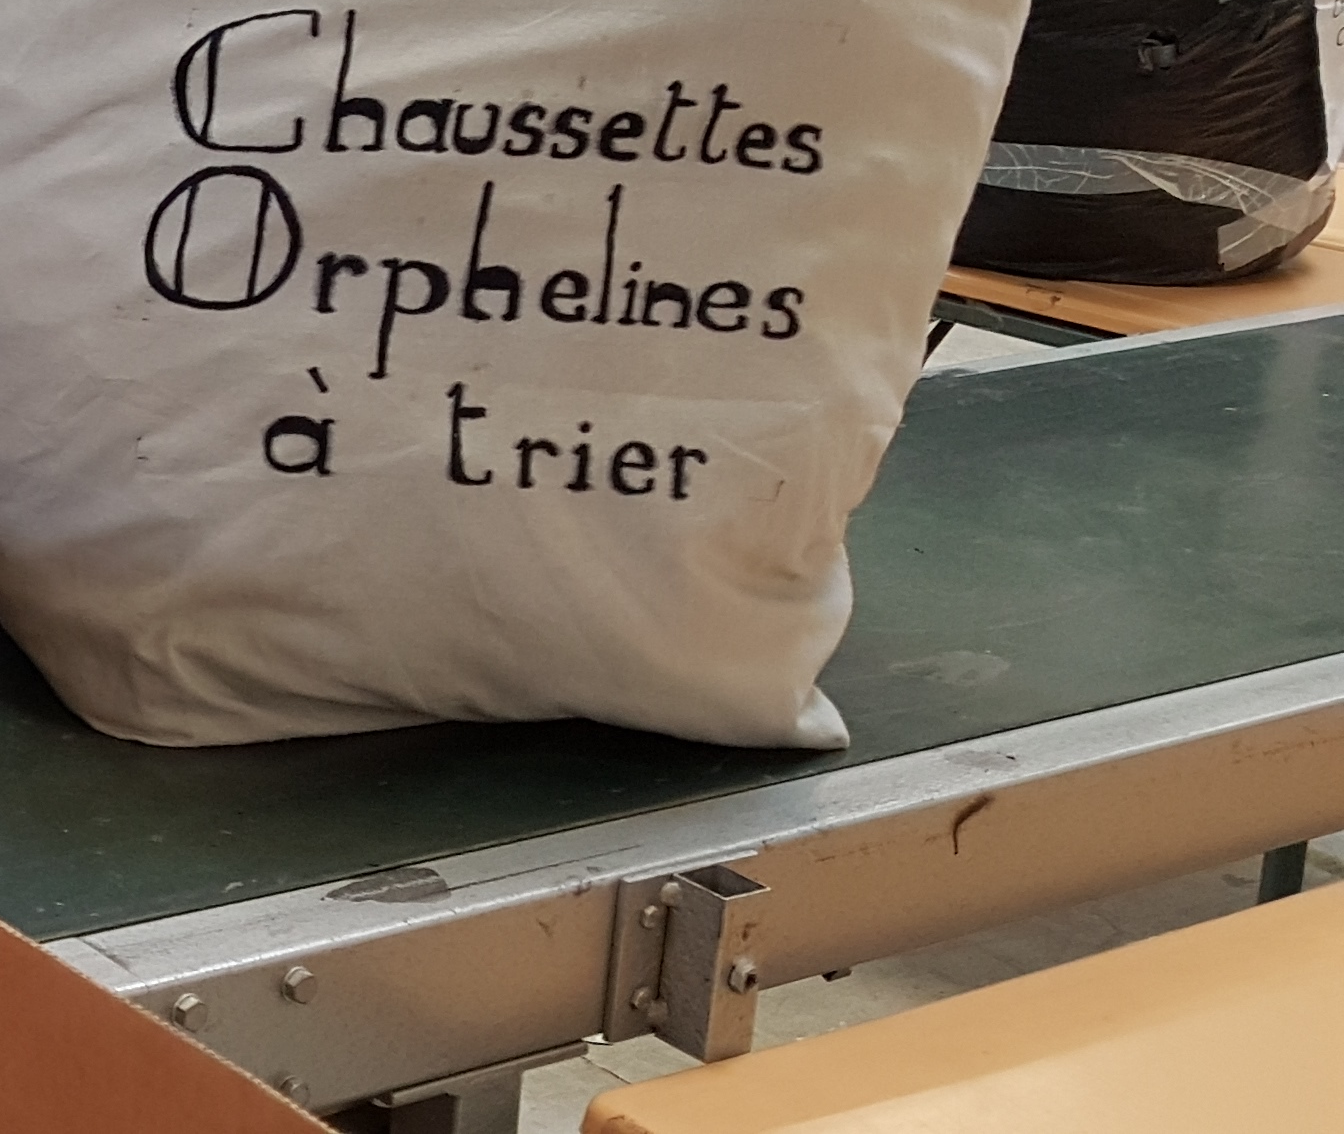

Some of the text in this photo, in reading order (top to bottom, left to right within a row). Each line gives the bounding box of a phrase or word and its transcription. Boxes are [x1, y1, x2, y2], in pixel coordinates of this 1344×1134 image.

[173, 8, 825, 175] Chaussettes
[144, 165, 806, 380] Orphelines
[263, 366, 710, 501] à trier
